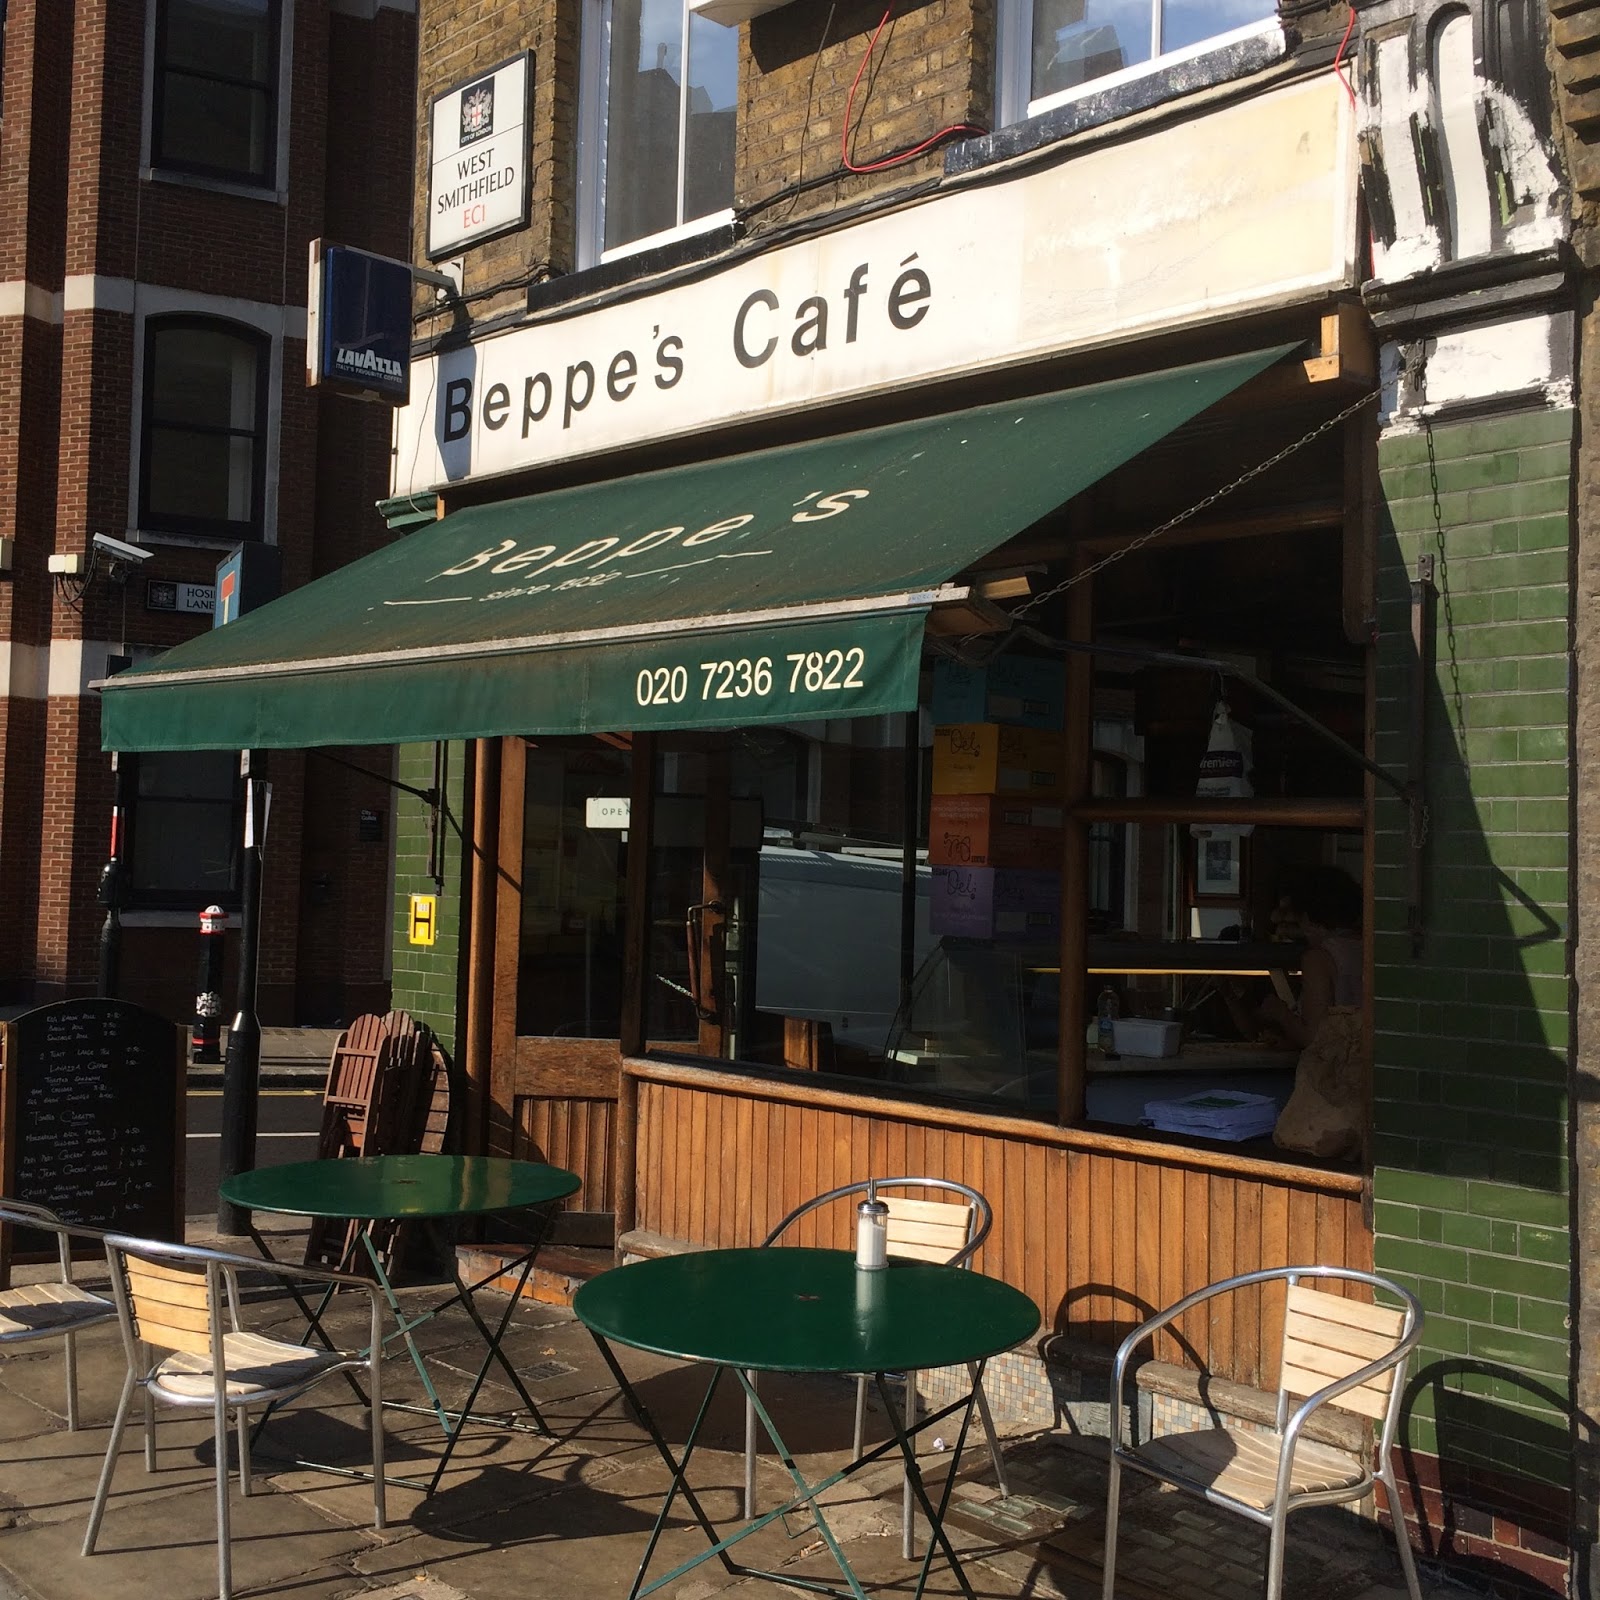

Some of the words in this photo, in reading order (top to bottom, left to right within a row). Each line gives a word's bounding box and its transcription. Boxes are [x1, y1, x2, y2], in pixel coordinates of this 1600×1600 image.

[457, 148, 495, 180] WEST
[437, 166, 515, 214] SMITHFIELD
[463, 204, 486, 229] EC1
[336, 348, 402, 377] LAVAZZA
[443, 324, 684, 443] Beppe's
[733, 252, 932, 368] Café
[383, 374, 403, 384] COFFEE
[187, 587, 216, 599] HOSI
[636, 665, 688, 706] 020
[700, 657, 773, 700] 7236
[786, 647, 865, 693] 7822
[413, 902, 432, 939] H
